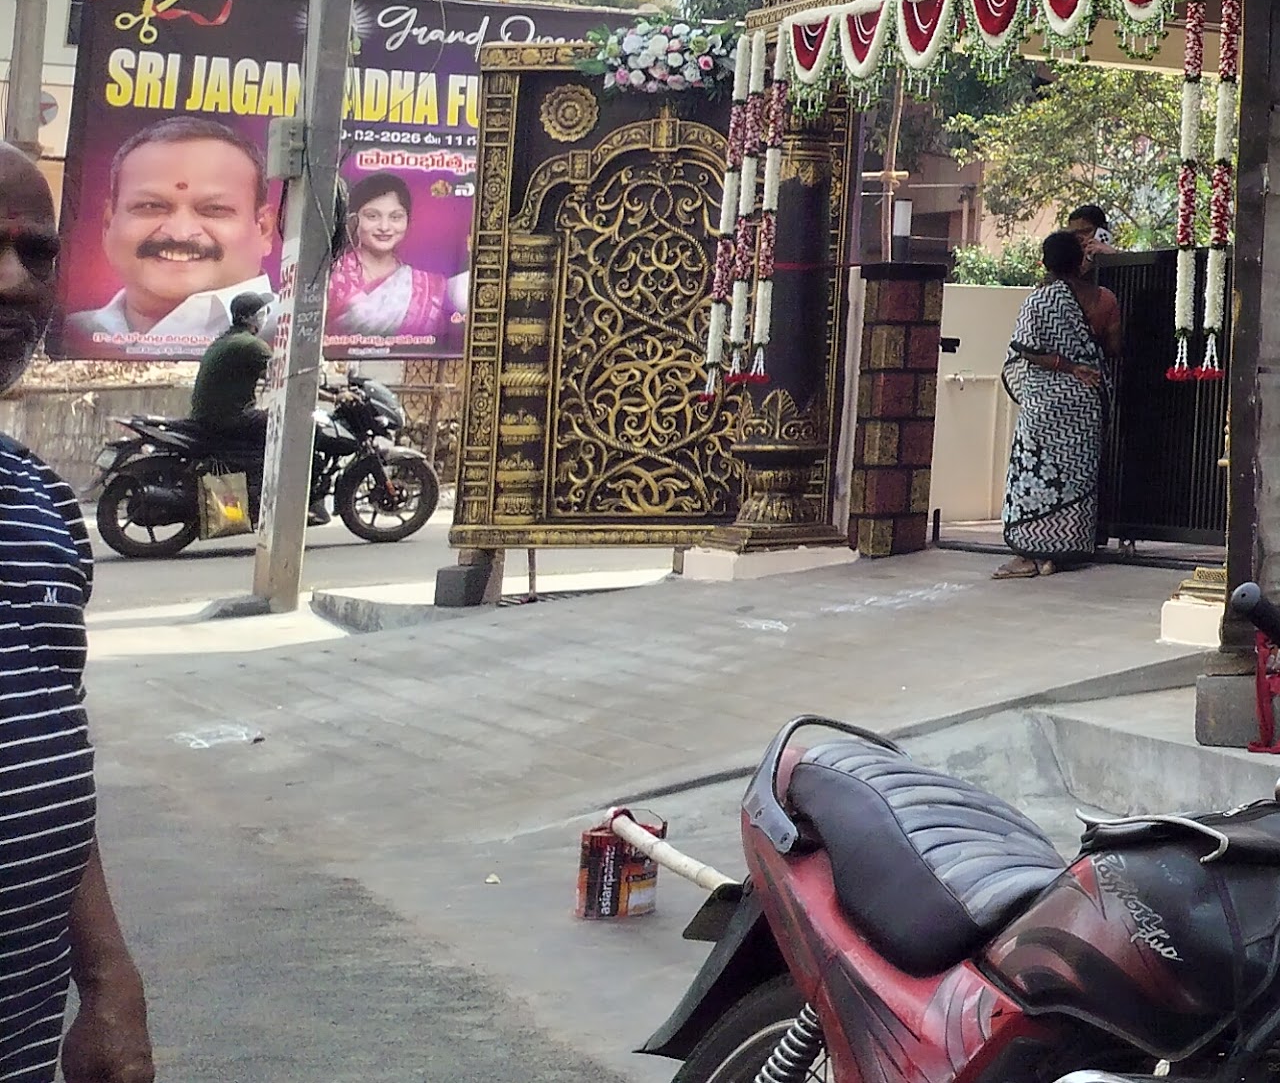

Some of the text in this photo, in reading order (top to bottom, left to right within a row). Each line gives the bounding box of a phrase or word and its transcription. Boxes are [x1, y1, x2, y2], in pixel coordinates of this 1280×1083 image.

[377, 5, 490, 62] Grand
[105, 47, 181, 110] SRI
[185, 55, 439, 126] JAGANADHA
